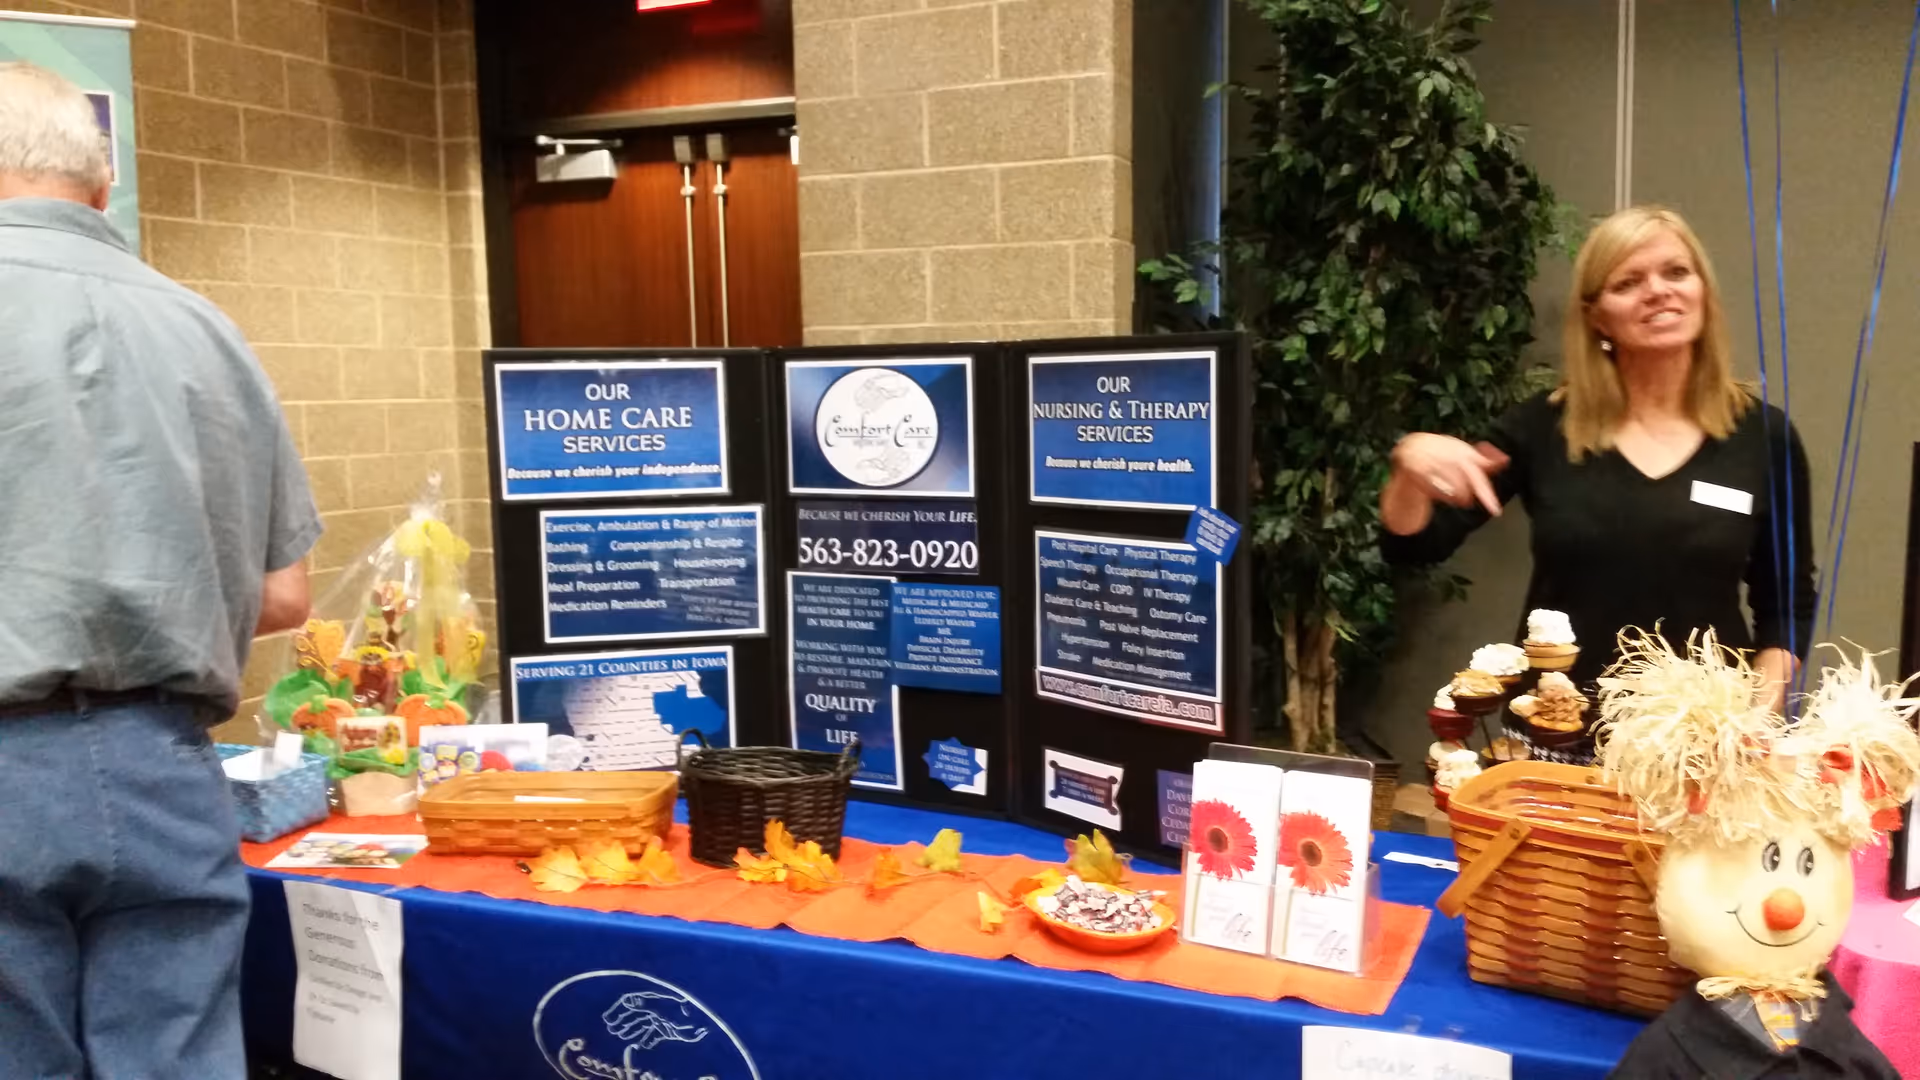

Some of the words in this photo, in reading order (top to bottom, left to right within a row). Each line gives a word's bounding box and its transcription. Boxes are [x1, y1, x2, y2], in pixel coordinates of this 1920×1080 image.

[585, 384, 630, 400] OUR
[1097, 376, 1131, 393] OUR
[524, 408, 611, 430] HOME
[622, 407, 692, 428] CARE
[1033, 403, 1103, 419] NURSING
[1108, 400, 1123, 419] &
[1128, 400, 1209, 419] THERAPY
[894, 414, 930, 447] Care
[1077, 425, 1154, 443] SERVICES
[563, 434, 665, 453] SERVICES
[1045, 456, 1077, 468] Because
[1079, 459, 1091, 469] we
[1093, 457, 1126, 470] cherish
[507, 467, 552, 480] Because
[555, 469, 570, 478] we
[573, 465, 613, 478] cherish
[615, 466, 640, 478] your
[799, 508, 841, 521] BECAUSE
[844, 509, 858, 521] WE
[861, 509, 910, 522] CHERISH
[913, 510, 946, 522] YOUR
[950, 511, 978, 523] LIFE.
[546, 520, 595, 533] Exercise,
[597, 519, 659, 532] Ambulation
[662, 519, 671, 530] &
[673, 518, 706, 531] Range
[707, 518, 719, 528] of
[721, 517, 757, 528] Motion
[546, 541, 588, 554] Bathing
[610, 538, 691, 552] Companionship
[693, 538, 702, 548] &
[704, 537, 744, 549] Respite
[800, 537, 979, 569] 563-823-0920
[1099, 544, 1118, 556] Care
[1160, 550, 1197, 565] Therapy
[547, 561, 594, 574] Dressing
[595, 561, 604, 571] &
[607, 559, 660, 573] Grooming
[673, 556, 747, 569] Housekeeping
[1066, 559, 1097, 574] Therapy
[1104, 564, 1159, 579] Occupational
[1160, 569, 1198, 585] Therapy
[549, 581, 574, 593] Meal
[576, 579, 640, 593] Preparation
[659, 576, 736, 590] Transportation
[1081, 579, 1100, 592] Care
[1154, 588, 1192, 604] Therapy
[549, 600, 608, 612] Medication
[610, 598, 667, 611] Reminders
[1075, 597, 1093, 610] Care
[1185, 612, 1208, 624] Care
[1141, 626, 1199, 643] Replacement
[516, 665, 575, 680] SERVING
[579, 663, 594, 676] 21
[598, 659, 667, 674] COUNTIES
[672, 658, 688, 669] IN
[691, 656, 728, 669] IOWA
[805, 693, 877, 714] QUALITY
